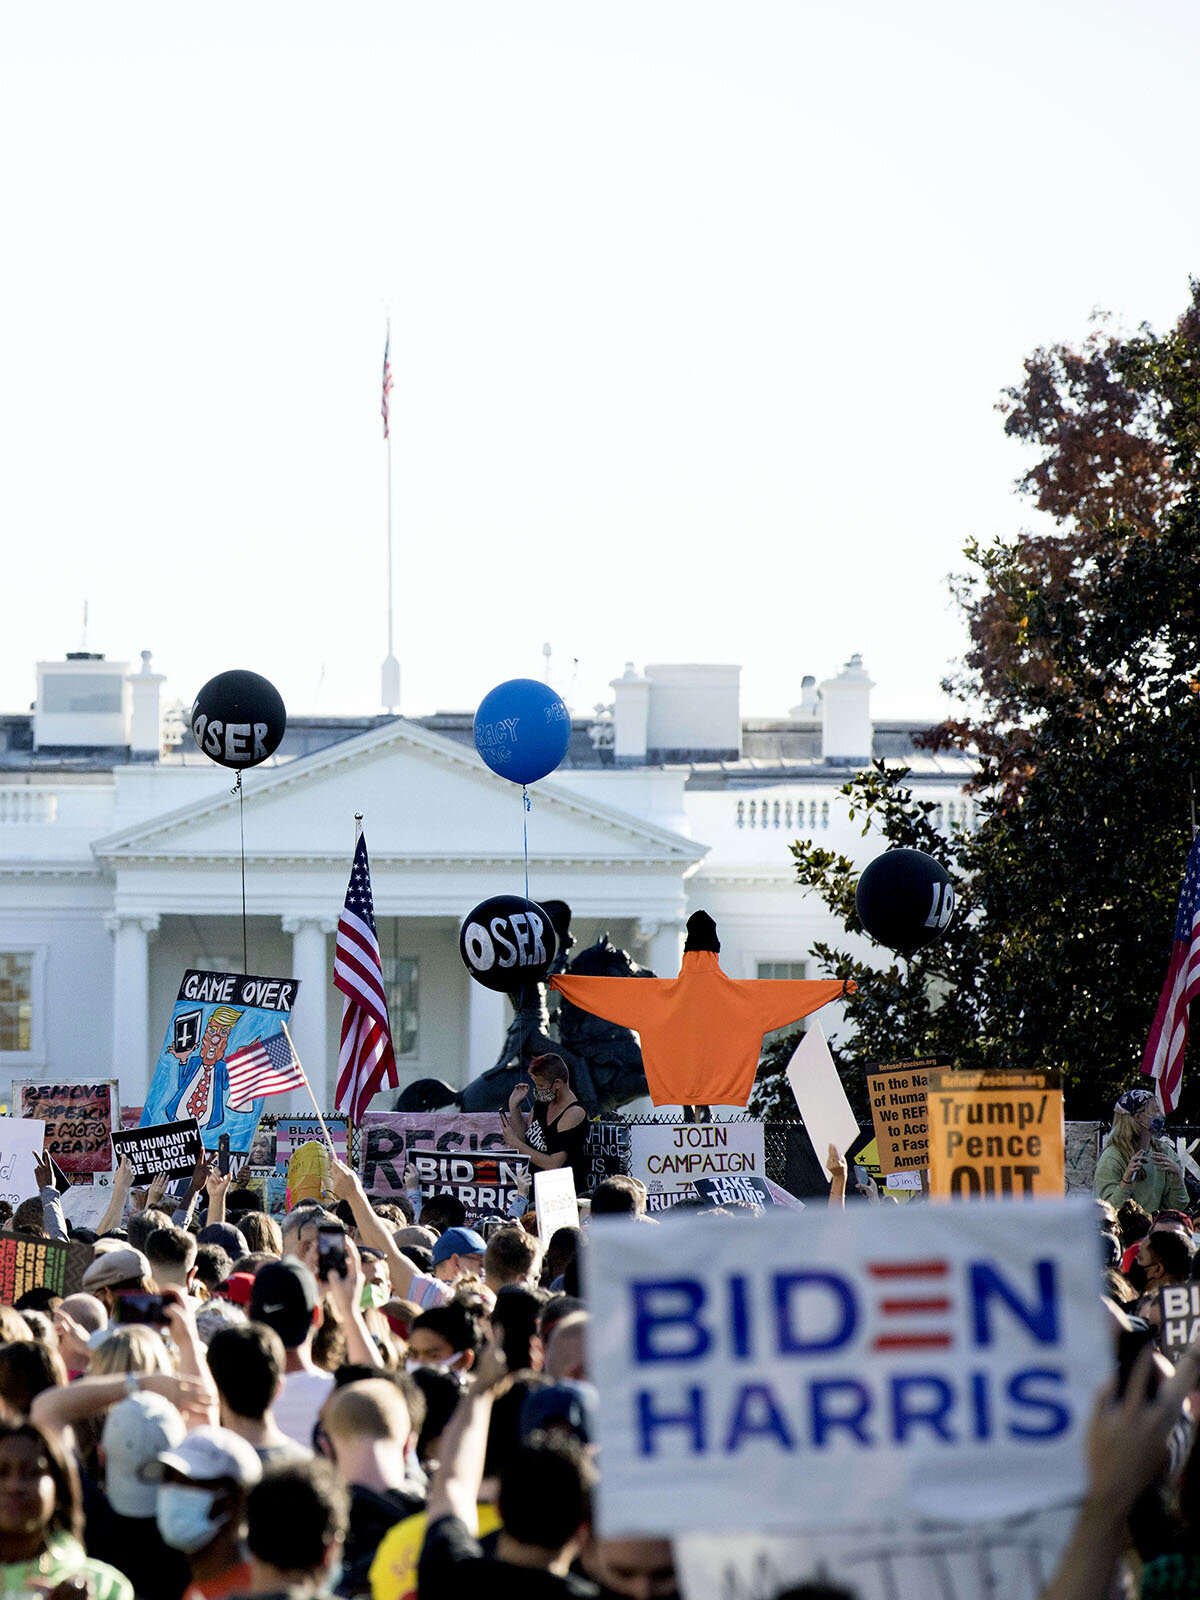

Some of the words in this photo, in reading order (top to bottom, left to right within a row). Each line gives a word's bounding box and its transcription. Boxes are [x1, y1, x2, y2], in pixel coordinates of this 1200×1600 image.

[465, 911, 546, 971] OSER
[184, 974, 236, 1001] GAME
[241, 982, 292, 1011] OVER
[879, 1059, 936, 1071] RefuseFascism.org
[24, 1085, 107, 1100] REMOVE
[873, 1080, 885, 1091] In
[889, 1078, 908, 1090] the
[912, 1075, 928, 1087] Na
[874, 1095, 885, 1107] of
[890, 1092, 928, 1105] Huma
[880, 1110, 899, 1122] We
[902, 1106, 928, 1120] REF
[940, 1095, 1047, 1130] Trump/
[58, 1122, 106, 1138] MOFO
[289, 1126, 333, 1135] BLACK
[525, 1125, 548, 1152] RUMP
[673, 1127, 727, 1148] JOIN
[888, 1126, 900, 1137] to
[904, 1123, 928, 1135] Acc
[115, 1141, 138, 1155] OUR
[140, 1129, 198, 1150] HUMANITY
[583, 1144, 627, 1158] ILENCE
[892, 1143, 899, 1152] a
[947, 1131, 1041, 1158] Pence
[132, 1150, 160, 1164] WILL
[161, 1144, 186, 1159] NOT
[647, 1152, 756, 1174] CAMPAIGN
[131, 1164, 145, 1175] BE
[146, 1154, 196, 1173] BROKEN
[415, 1157, 523, 1185] BIDEN
[591, 1158, 605, 1173] IS
[708, 1177, 754, 1190] TAKE
[15, 1241, 26, 1267] GOOD
[26, 1243, 36, 1261] GET
[36, 1244, 47, 1259] DO
[630, 1258, 1061, 1366] BIDEN
[636, 1366, 1072, 1457] HARRIS
